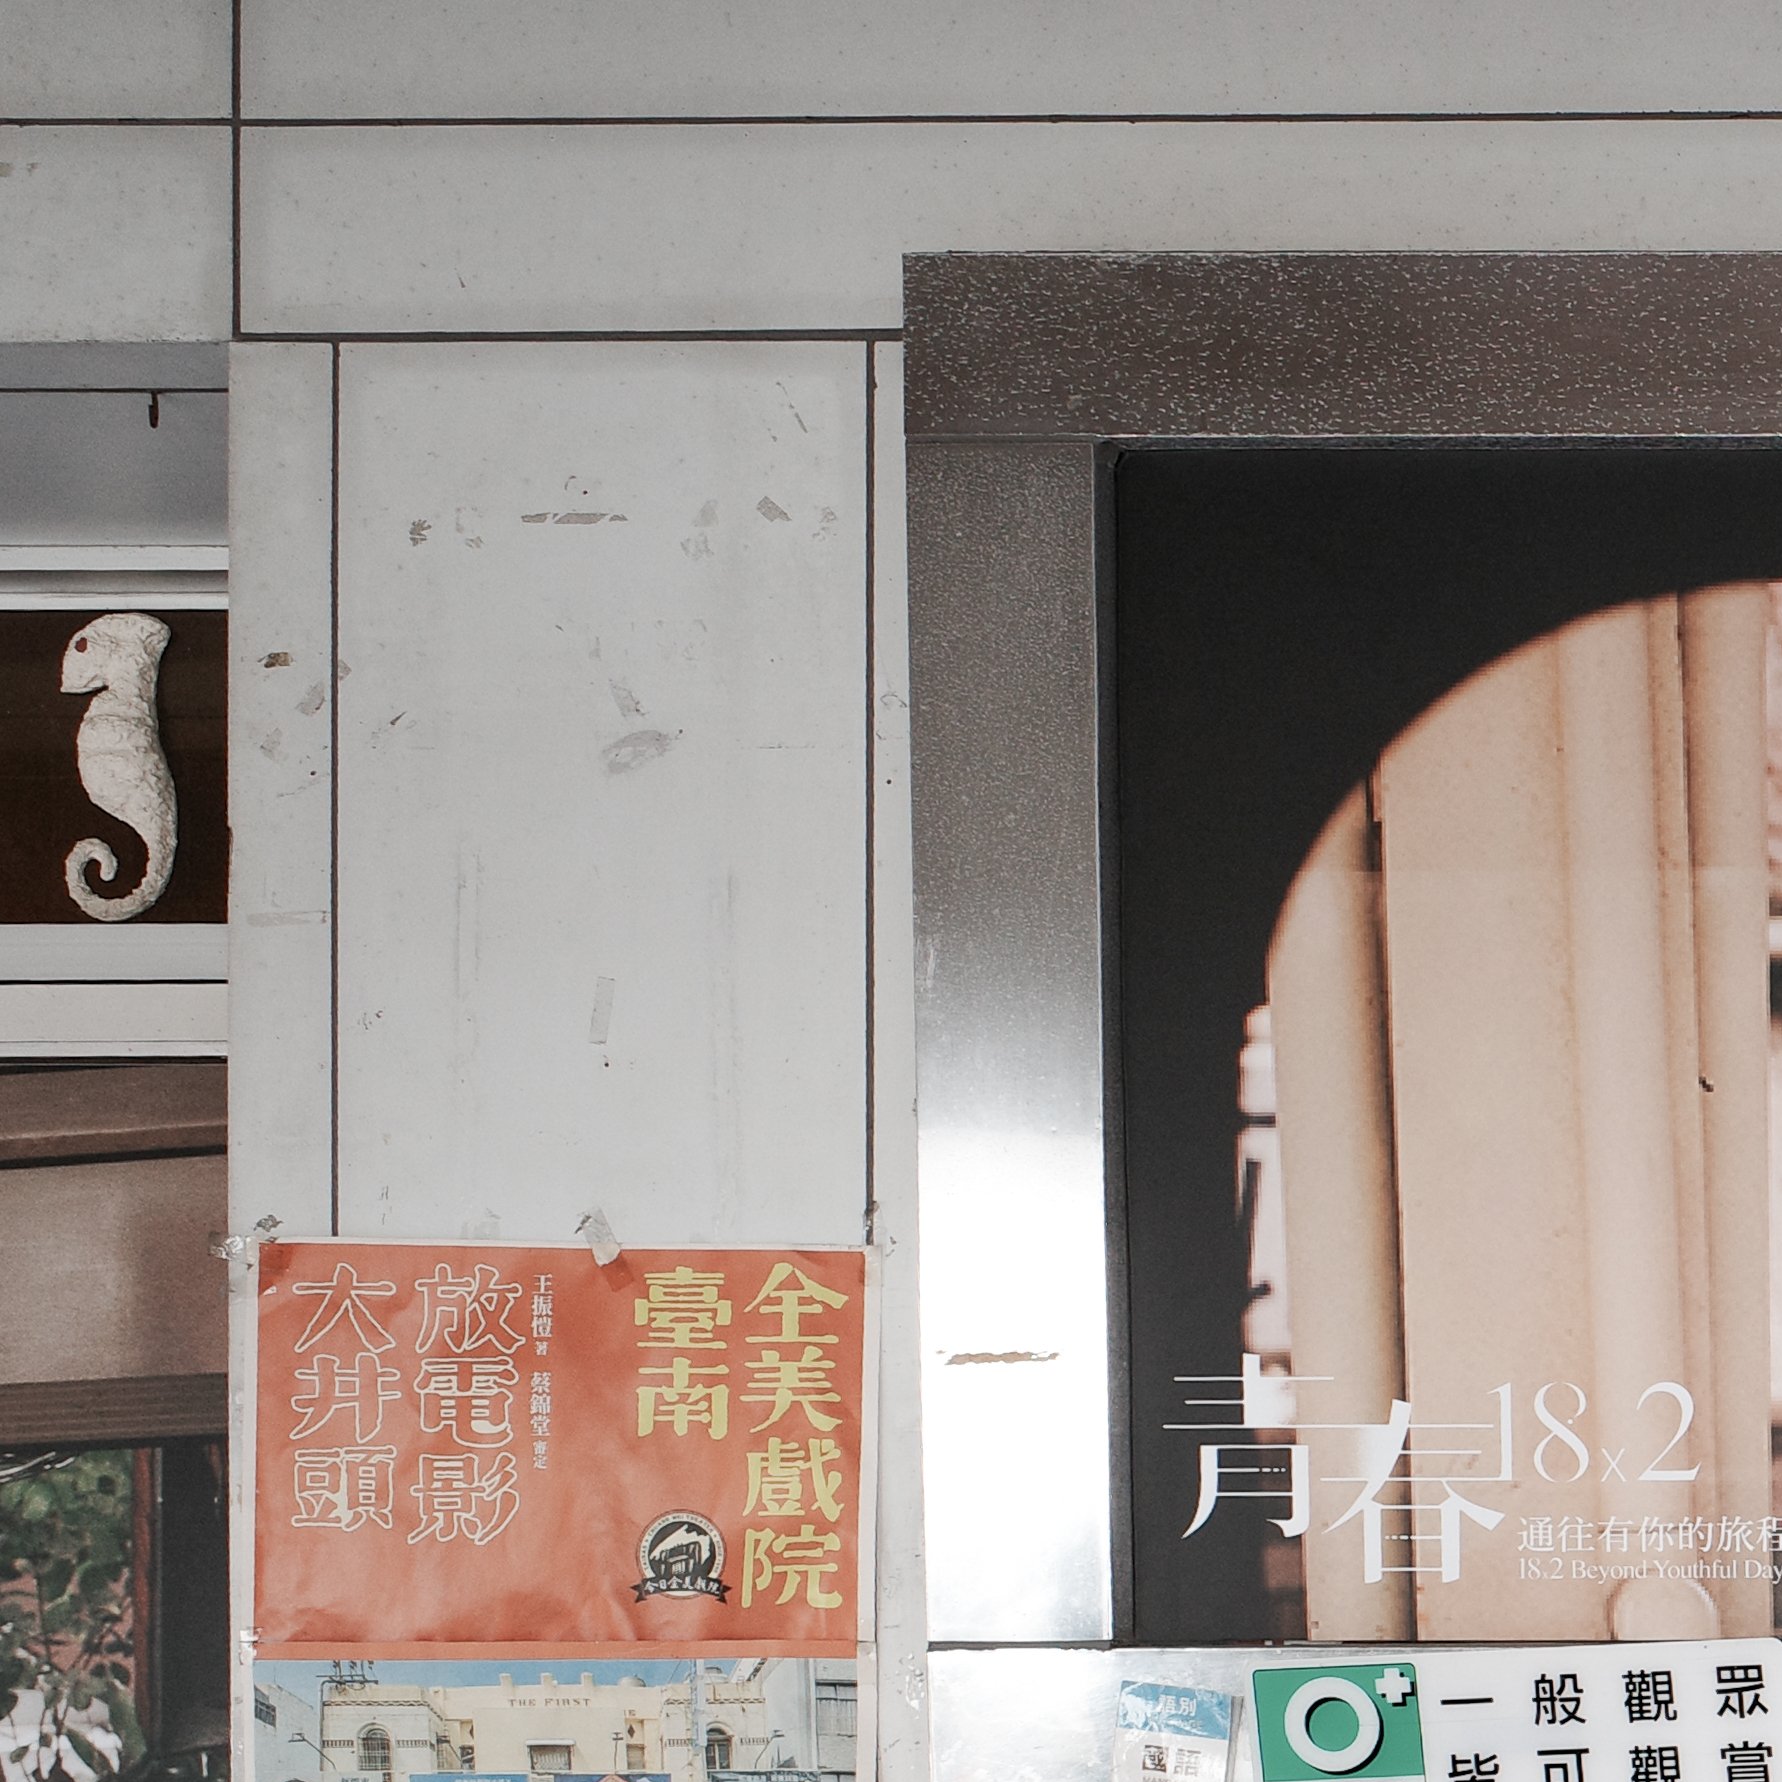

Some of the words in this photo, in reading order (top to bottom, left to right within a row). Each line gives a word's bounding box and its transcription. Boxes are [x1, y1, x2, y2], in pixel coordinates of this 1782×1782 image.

[291, 1262, 402, 1533] 大井頭
[407, 1262, 526, 1546] 放電影
[632, 1267, 733, 1440] 臺南
[741, 1262, 850, 1610] 全美戲院
[1162, 1353, 1508, 1586] 青春
[1571, 1559, 1649, 1585] Beyond
[1653, 1559, 1741, 1581] Youthful
[1439, 1663, 1770, 1728] 一般觀眾
